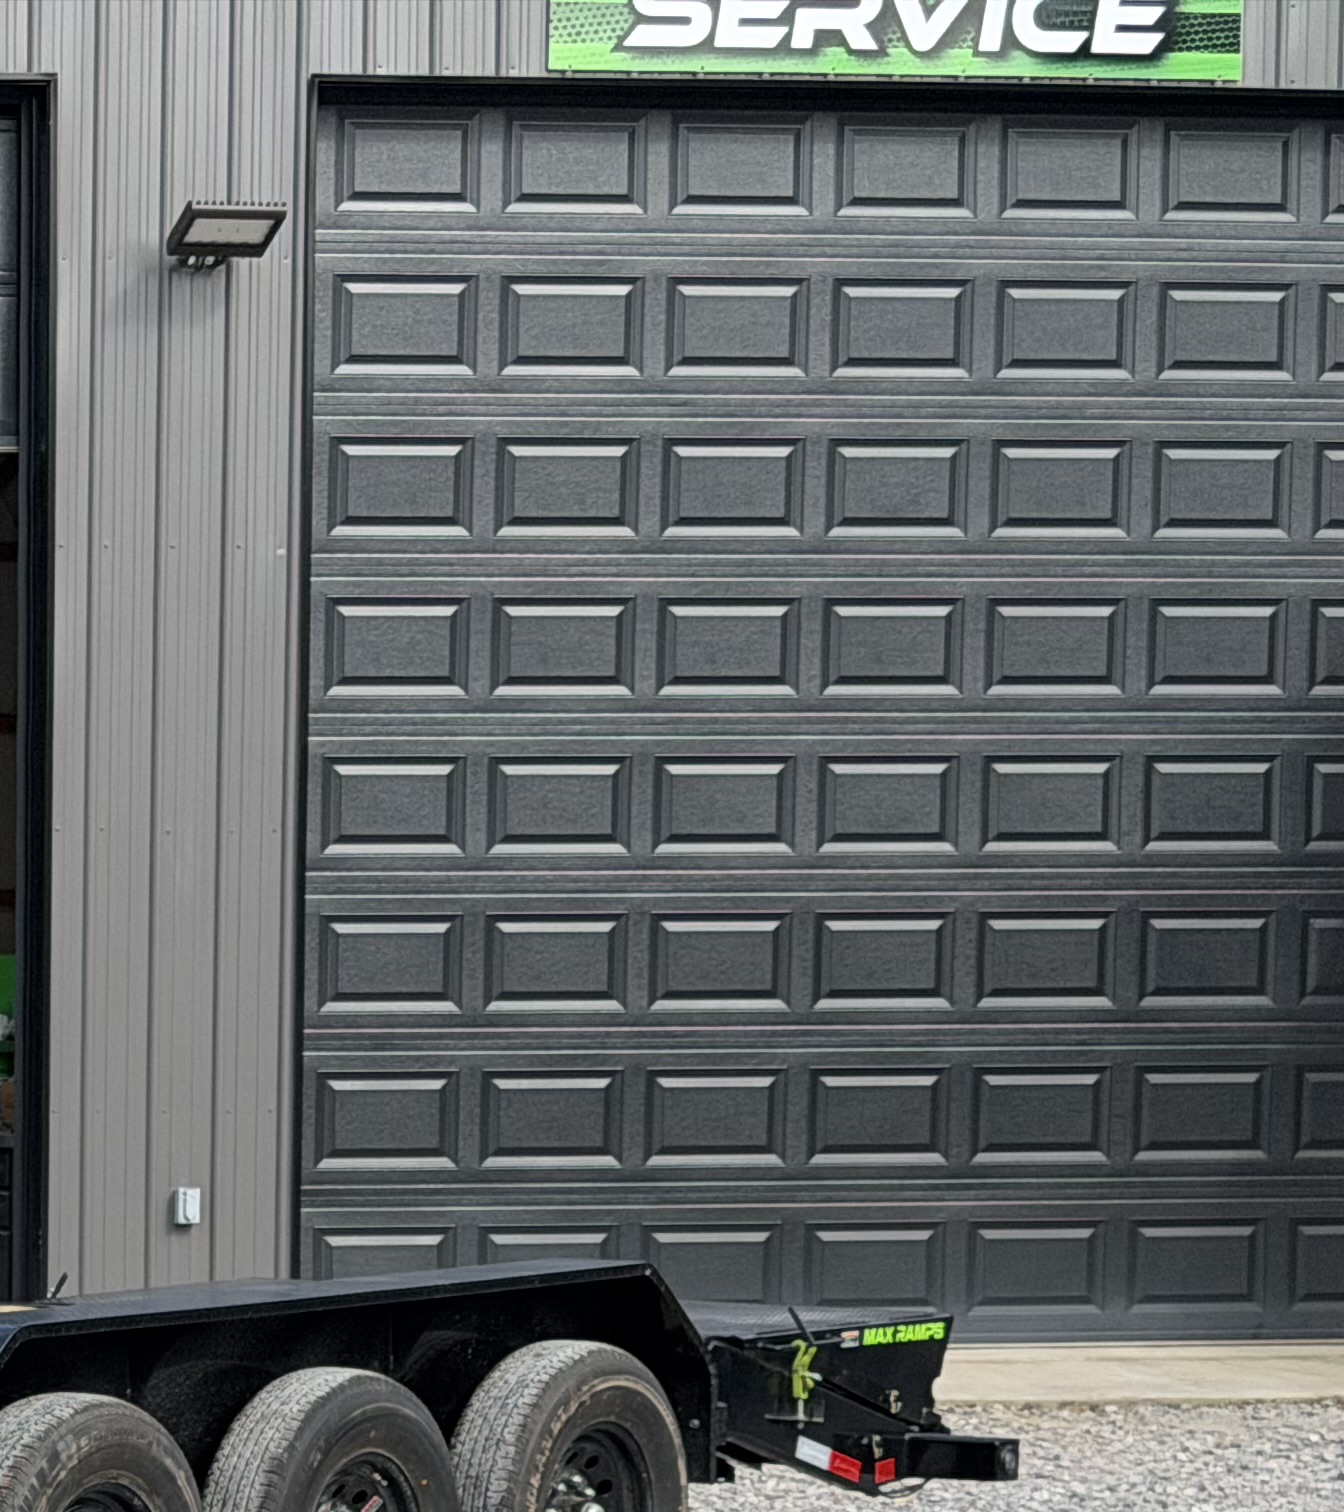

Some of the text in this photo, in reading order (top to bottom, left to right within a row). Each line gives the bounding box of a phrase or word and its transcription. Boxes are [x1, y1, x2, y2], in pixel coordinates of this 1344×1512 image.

[622, 0, 1168, 54] SERVICE
[862, 1326, 895, 1346] MAX
[895, 1321, 946, 1342] RAMPS
